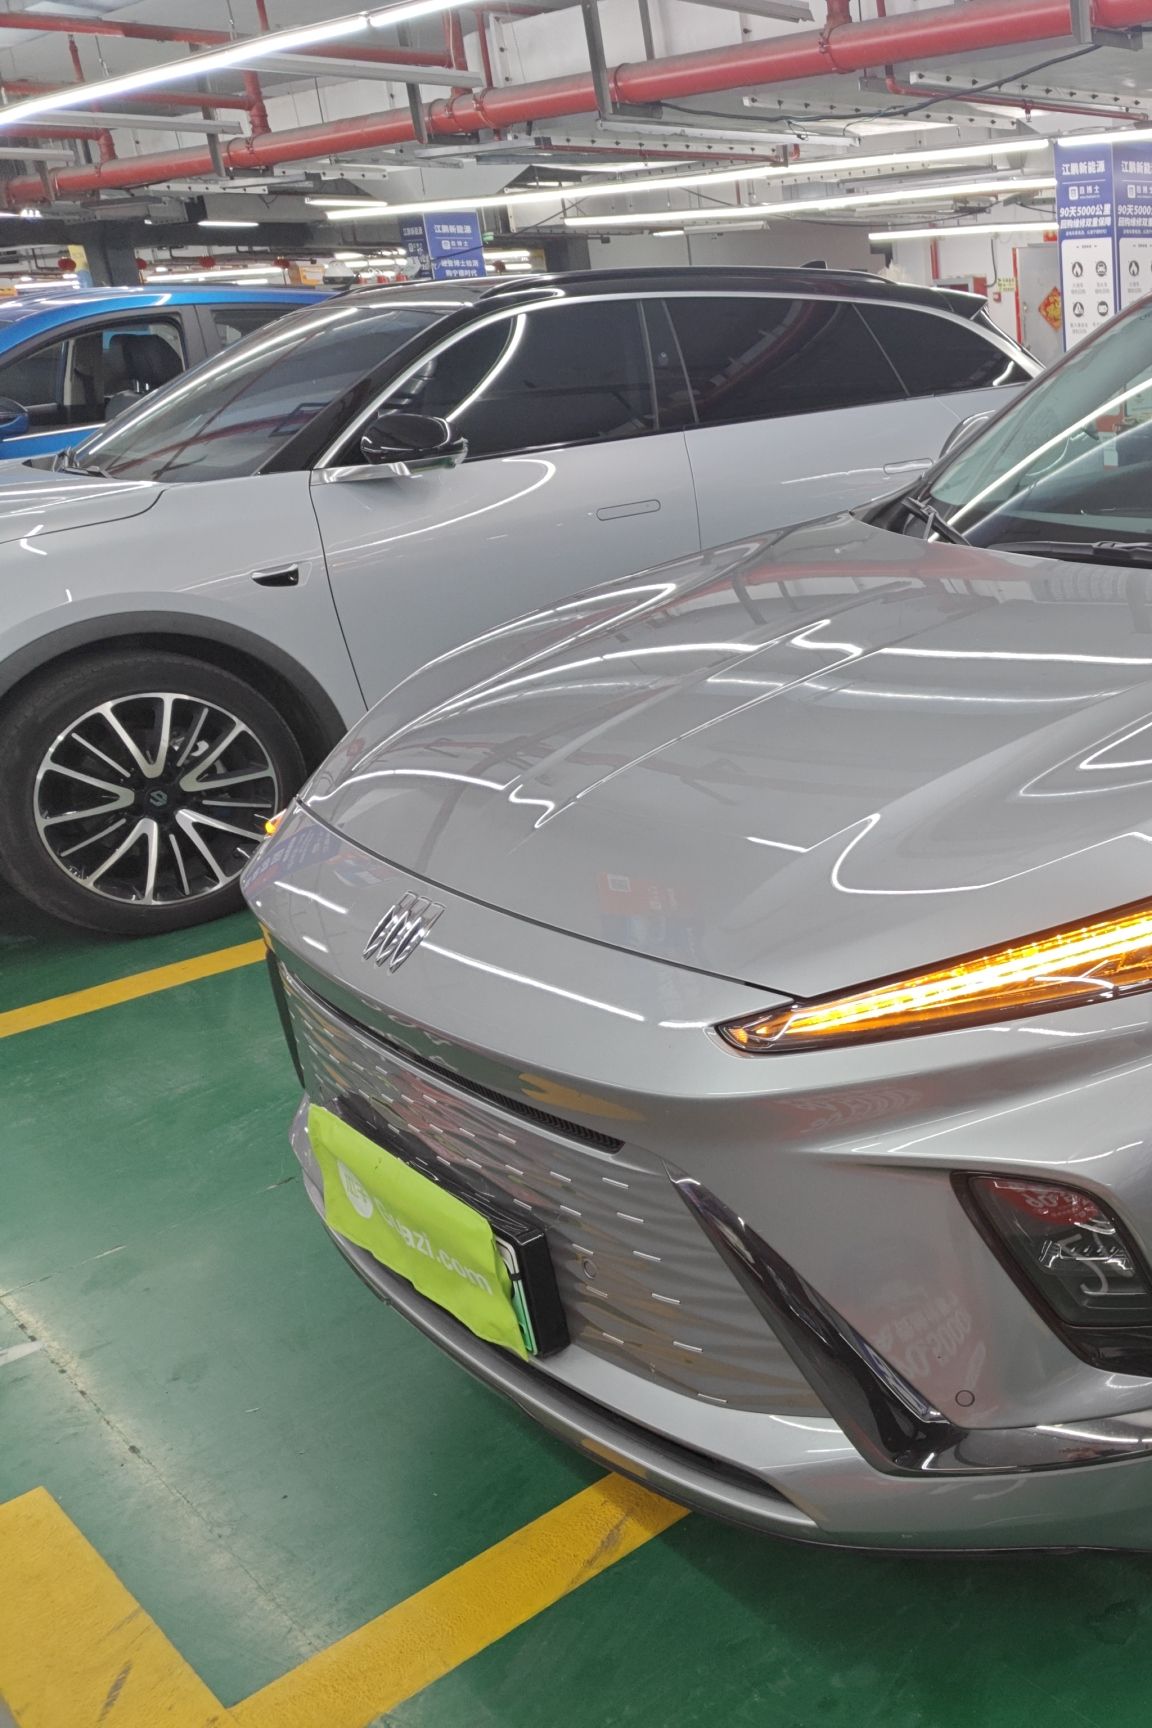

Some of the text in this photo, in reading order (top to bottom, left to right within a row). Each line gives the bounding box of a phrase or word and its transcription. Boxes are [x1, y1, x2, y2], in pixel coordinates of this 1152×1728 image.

[1059, 203, 1111, 217] 90天5000公里
[374, 1196, 494, 1297] Guazi.com
